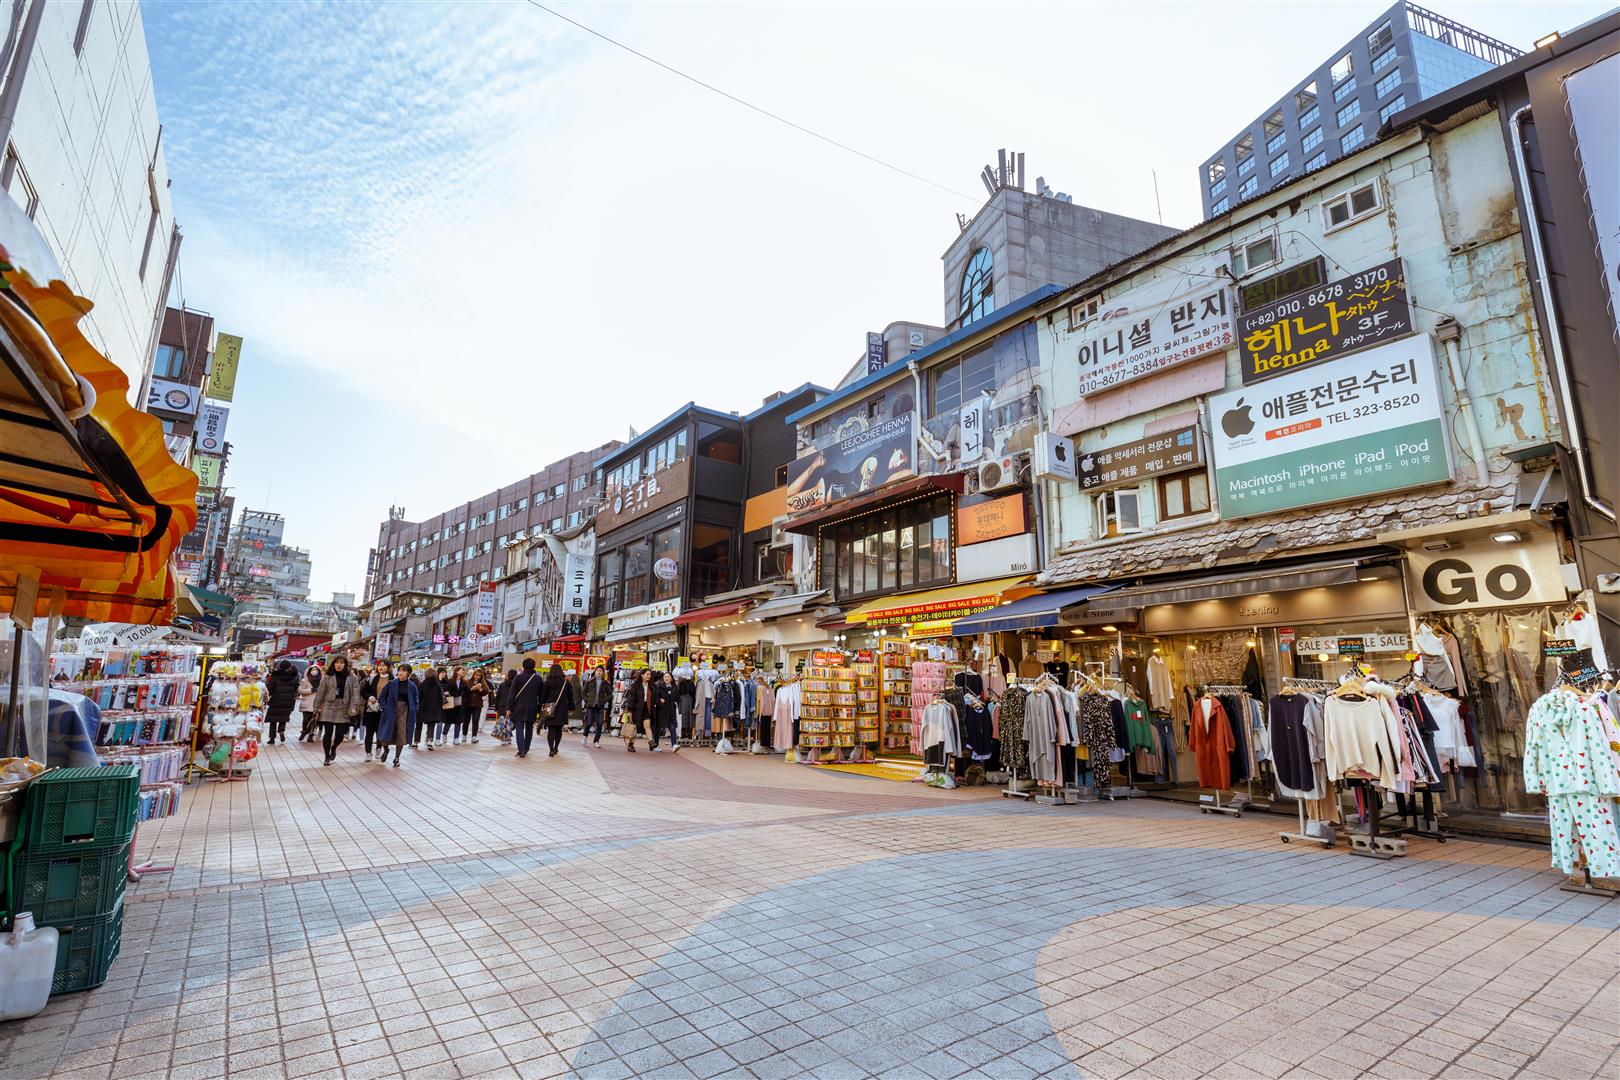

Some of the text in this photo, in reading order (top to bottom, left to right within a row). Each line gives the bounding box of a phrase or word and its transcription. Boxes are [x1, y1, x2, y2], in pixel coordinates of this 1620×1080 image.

[1347, 279, 1397, 301] ヘンナ
[1078, 288, 1227, 366] 이니셜 반지
[1243, 301, 1346, 353] 헤나
[1246, 312, 1275, 330] (+82)
[1358, 310, 1389, 330] 3F
[1254, 338, 1331, 374] henna
[1080, 358, 1158, 393] 010-8677-8384
[1263, 358, 1418, 420] 애플전문수리
[1326, 393, 1421, 425] TEL 323-8520
[841, 427, 880, 450] LEEJOOHEE
[882, 415, 910, 433] HENNA
[964, 408, 981, 454] 헤나
[1083, 476, 1100, 487] 중고
[1101, 470, 1118, 482] 애플
[1120, 465, 1138, 477] 제품
[1145, 459, 1163, 471] 매입
[1172, 451, 1193, 465] 판매
[1097, 454, 1112, 465] 애플
[1114, 446, 1145, 461] 악세서리
[1229, 438, 1429, 492] Macintosh iPhone iPad iPod
[1320, 471, 1348, 482] 아이폰
[1354, 463, 1392, 475] 아이패드
[573, 570, 585, 608] 三丁目
[1298, 641, 1320, 651] SALE
[1380, 636, 1406, 647] SALE
